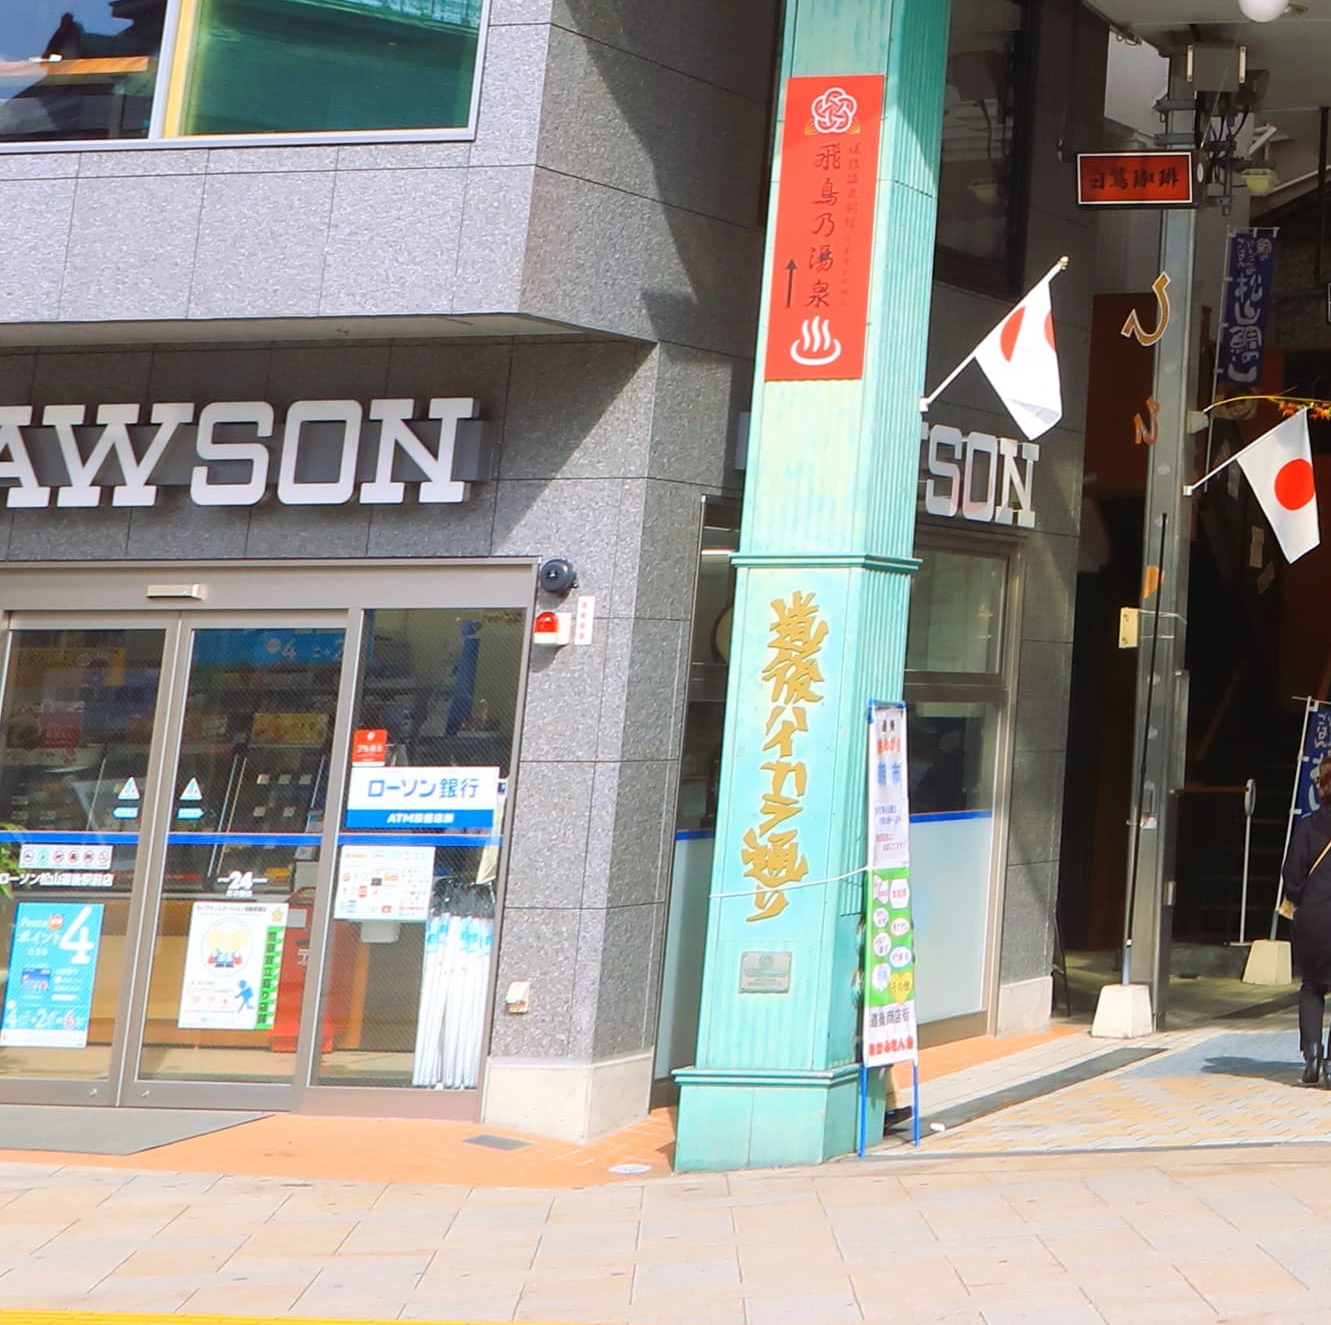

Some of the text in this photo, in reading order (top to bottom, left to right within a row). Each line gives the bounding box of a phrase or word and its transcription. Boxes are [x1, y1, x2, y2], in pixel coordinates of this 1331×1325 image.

[805, 142, 842, 307] 飛鳥乃湯泉
[920, 421, 1040, 528] SON
[367, 778, 480, 799] ローソン銀行
[740, 589, 830, 924] 道後ハイカラ通り
